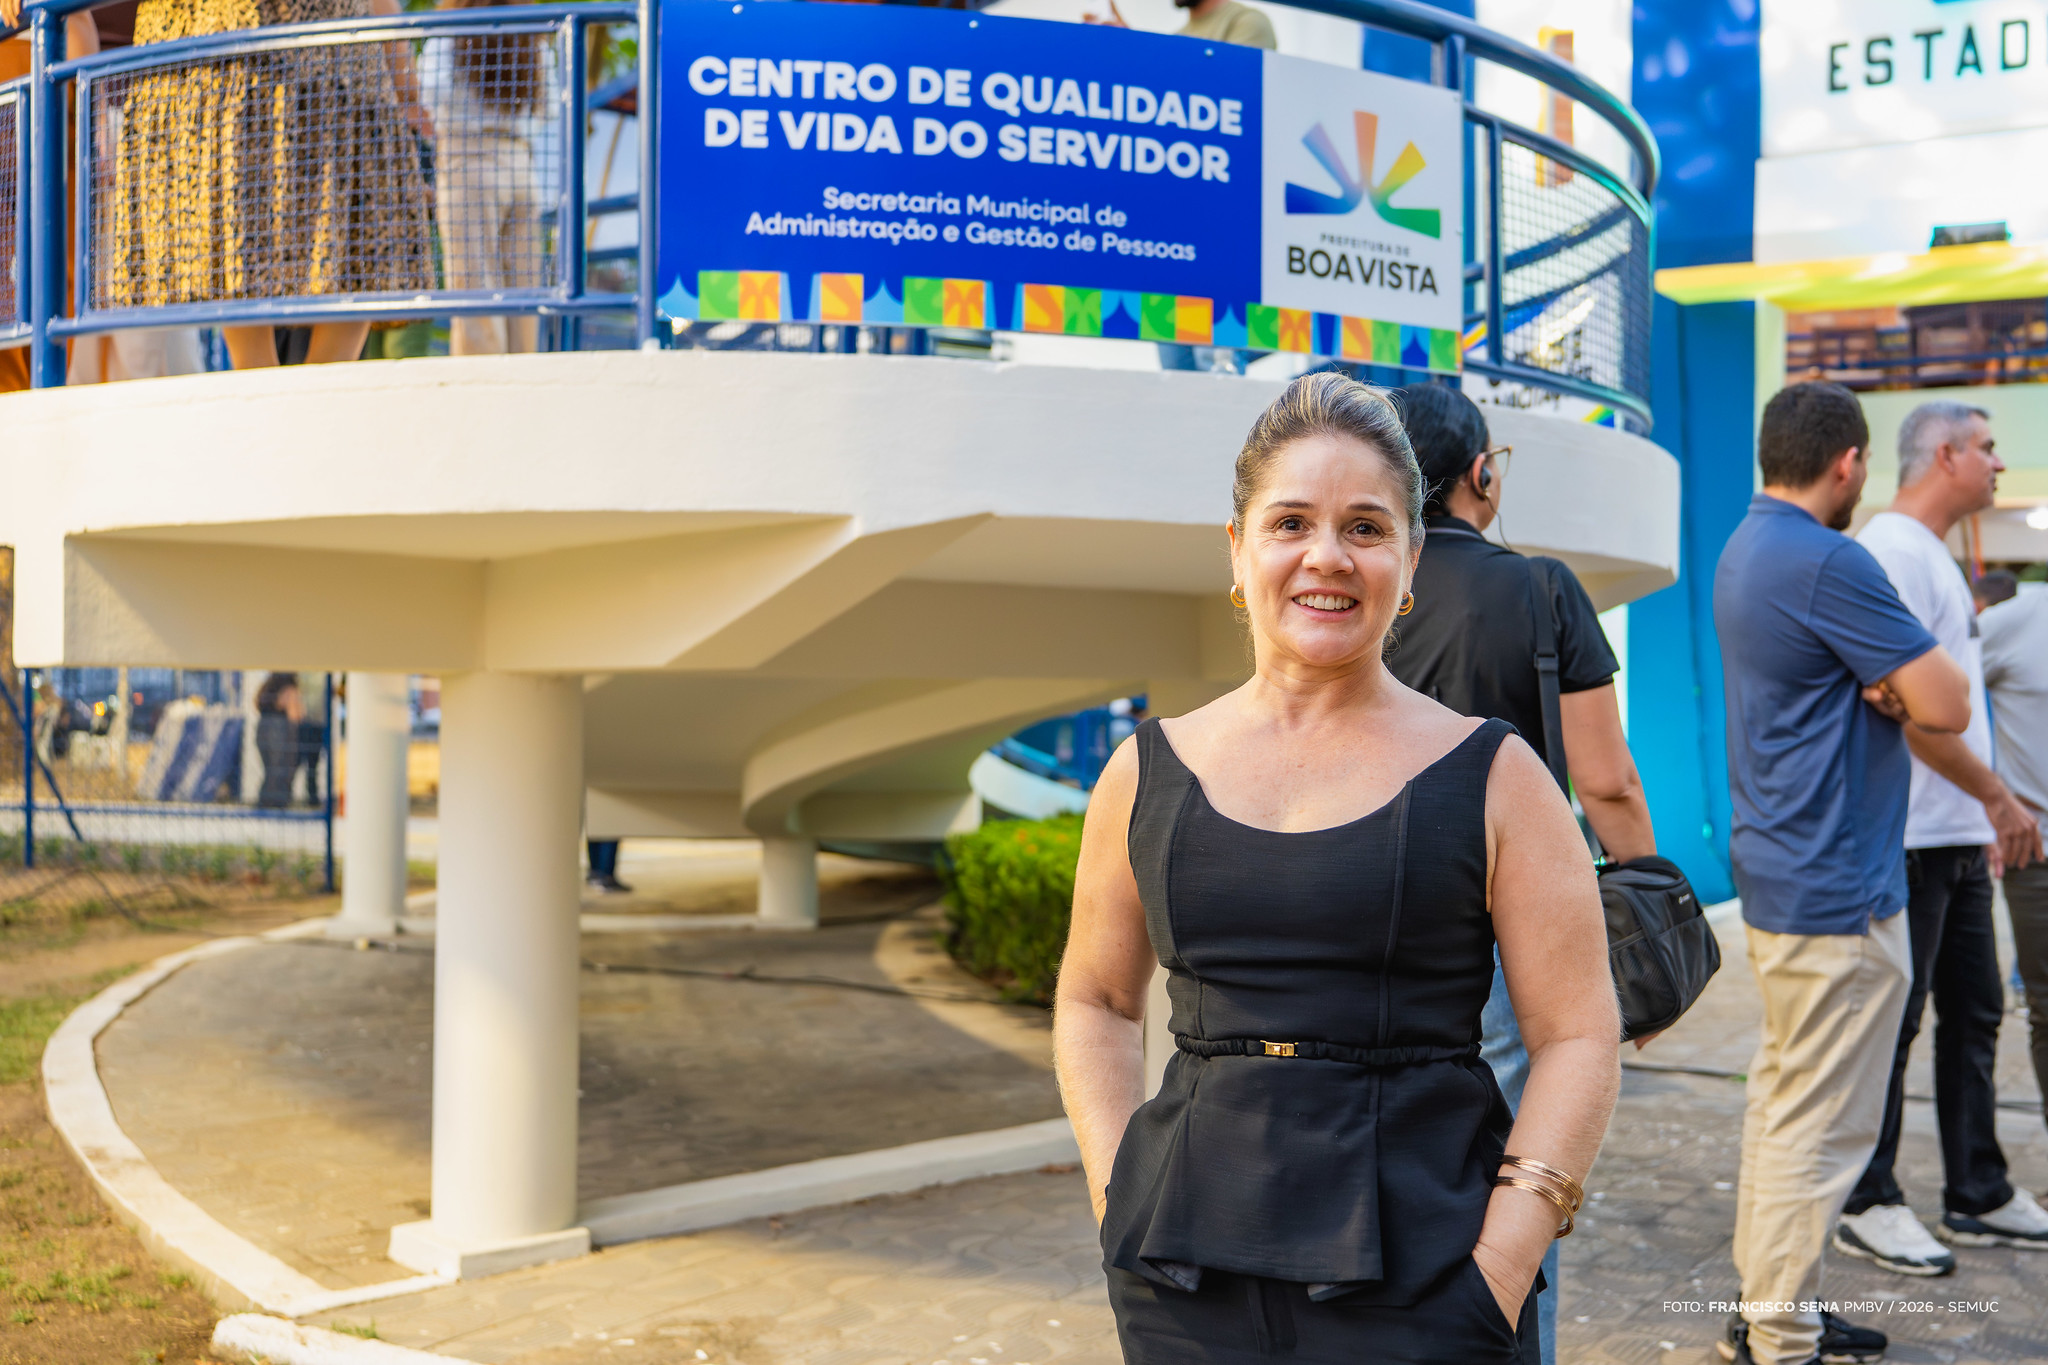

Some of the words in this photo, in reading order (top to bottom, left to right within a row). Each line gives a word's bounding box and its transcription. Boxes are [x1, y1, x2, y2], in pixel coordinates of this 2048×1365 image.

[1828, 20, 2048, 92] ESTAD
[688, 55, 897, 103] CENTRO
[908, 66, 972, 108] DE
[981, 72, 1243, 137] QUALIDADE
[704, 108, 769, 149] DE
[777, 110, 903, 154] VIDA
[913, 117, 988, 159] DO
[998, 124, 1231, 183] SERVIDOR
[745, 211, 938, 246] Administração
[942, 225, 960, 243] e
[965, 221, 1059, 250] Gestão
[1064, 229, 1096, 253] de
[1101, 232, 1197, 262] Pessoas
[823, 186, 961, 215] Secretaria
[965, 193, 1090, 226] Municipal
[1095, 206, 1128, 228] de
[1320, 232, 1392, 255] PREFEITURA
[1395, 246, 1411, 257] DE
